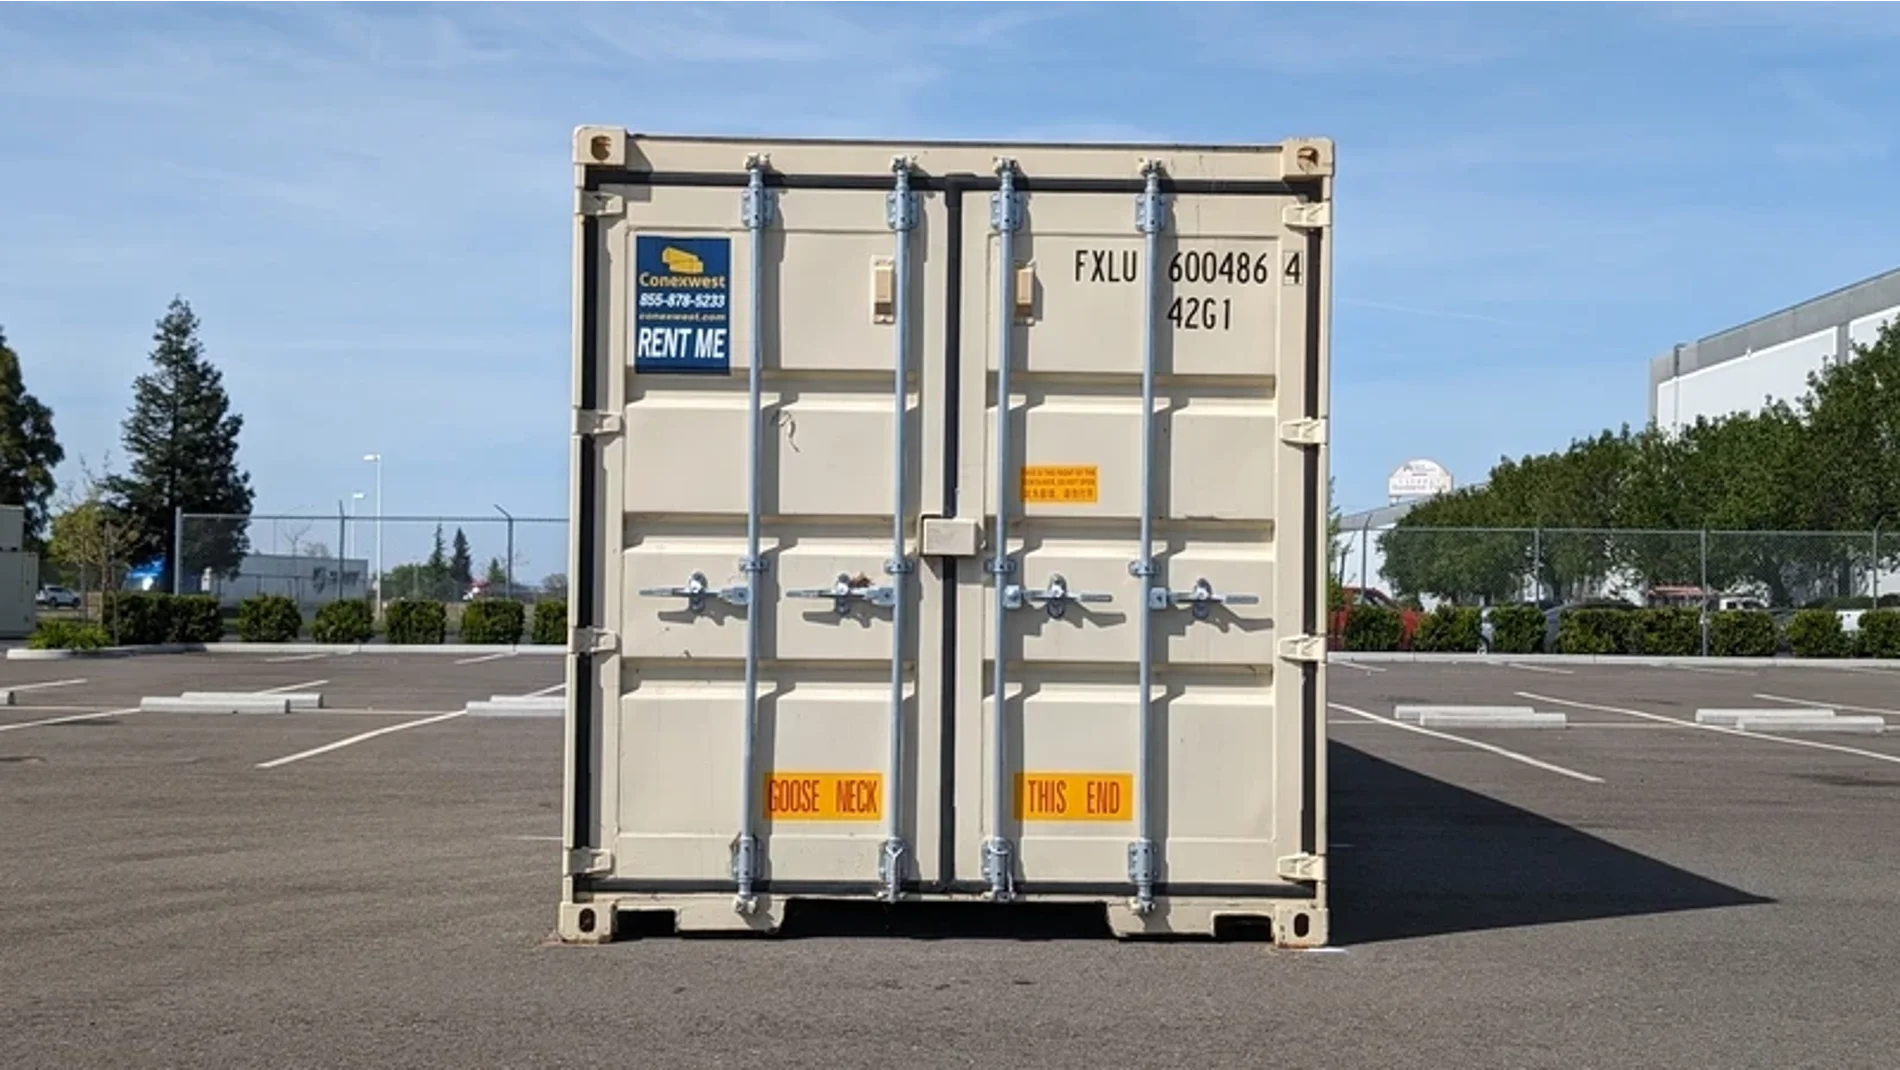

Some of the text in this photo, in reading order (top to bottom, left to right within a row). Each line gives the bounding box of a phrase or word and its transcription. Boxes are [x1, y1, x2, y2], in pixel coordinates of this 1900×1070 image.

[639, 272, 726, 289] Conexwest
[1075, 250, 1300, 284] FXLU 600486 4
[638, 292, 726, 308] 855-878-5233
[1167, 297, 1231, 330] 42G1
[638, 327, 727, 358] RENT ME
[768, 779, 878, 814] GOOSE NECK
[1027, 780, 1121, 815] THIS END
